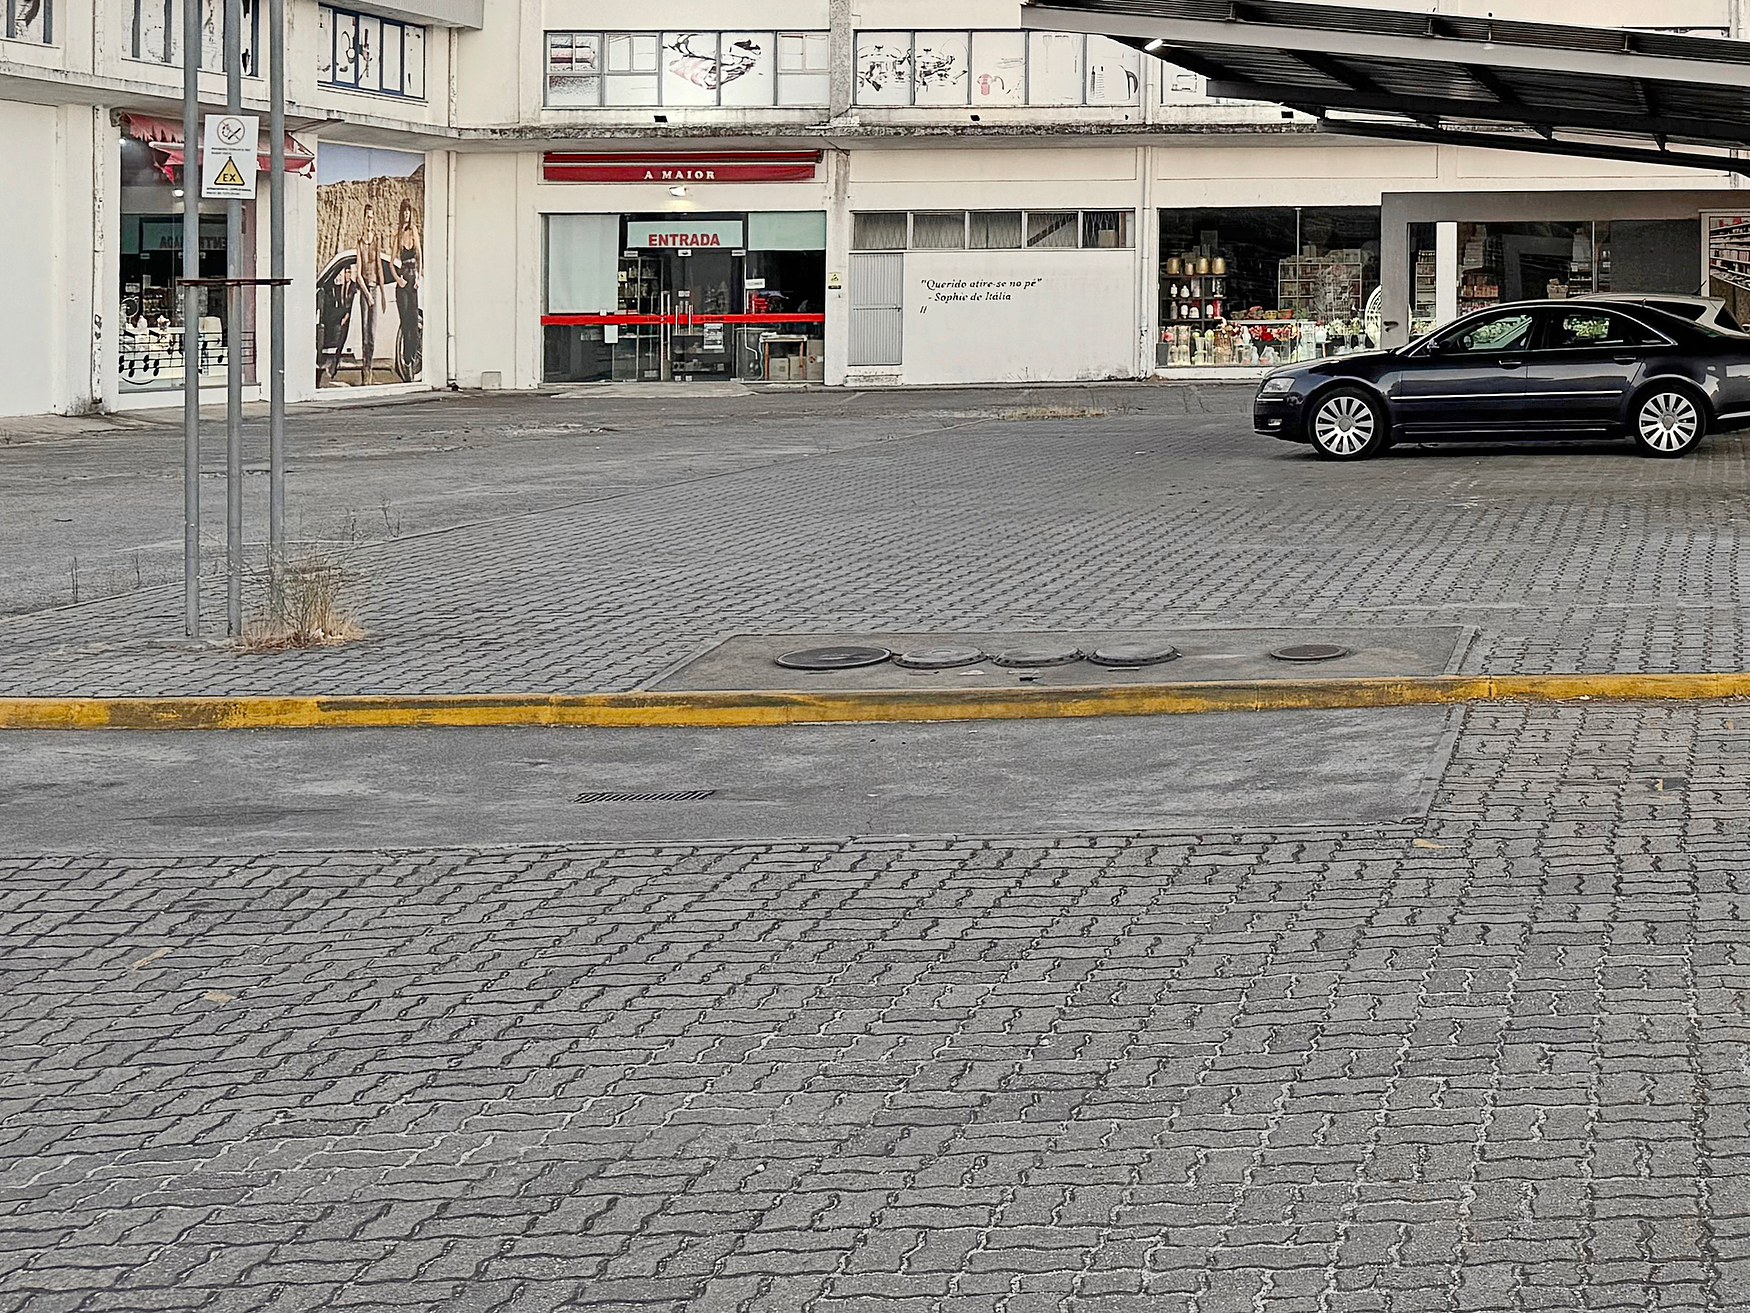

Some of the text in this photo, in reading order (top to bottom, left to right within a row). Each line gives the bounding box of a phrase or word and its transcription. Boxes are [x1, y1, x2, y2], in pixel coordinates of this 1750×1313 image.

[222, 173, 236, 182] EX
[644, 170, 715, 179] A MAIOR
[648, 233, 720, 246] ENTRADA
[934, 292, 968, 303] Sophie
[970, 292, 982, 301] de
[985, 292, 1011, 301] Itália
